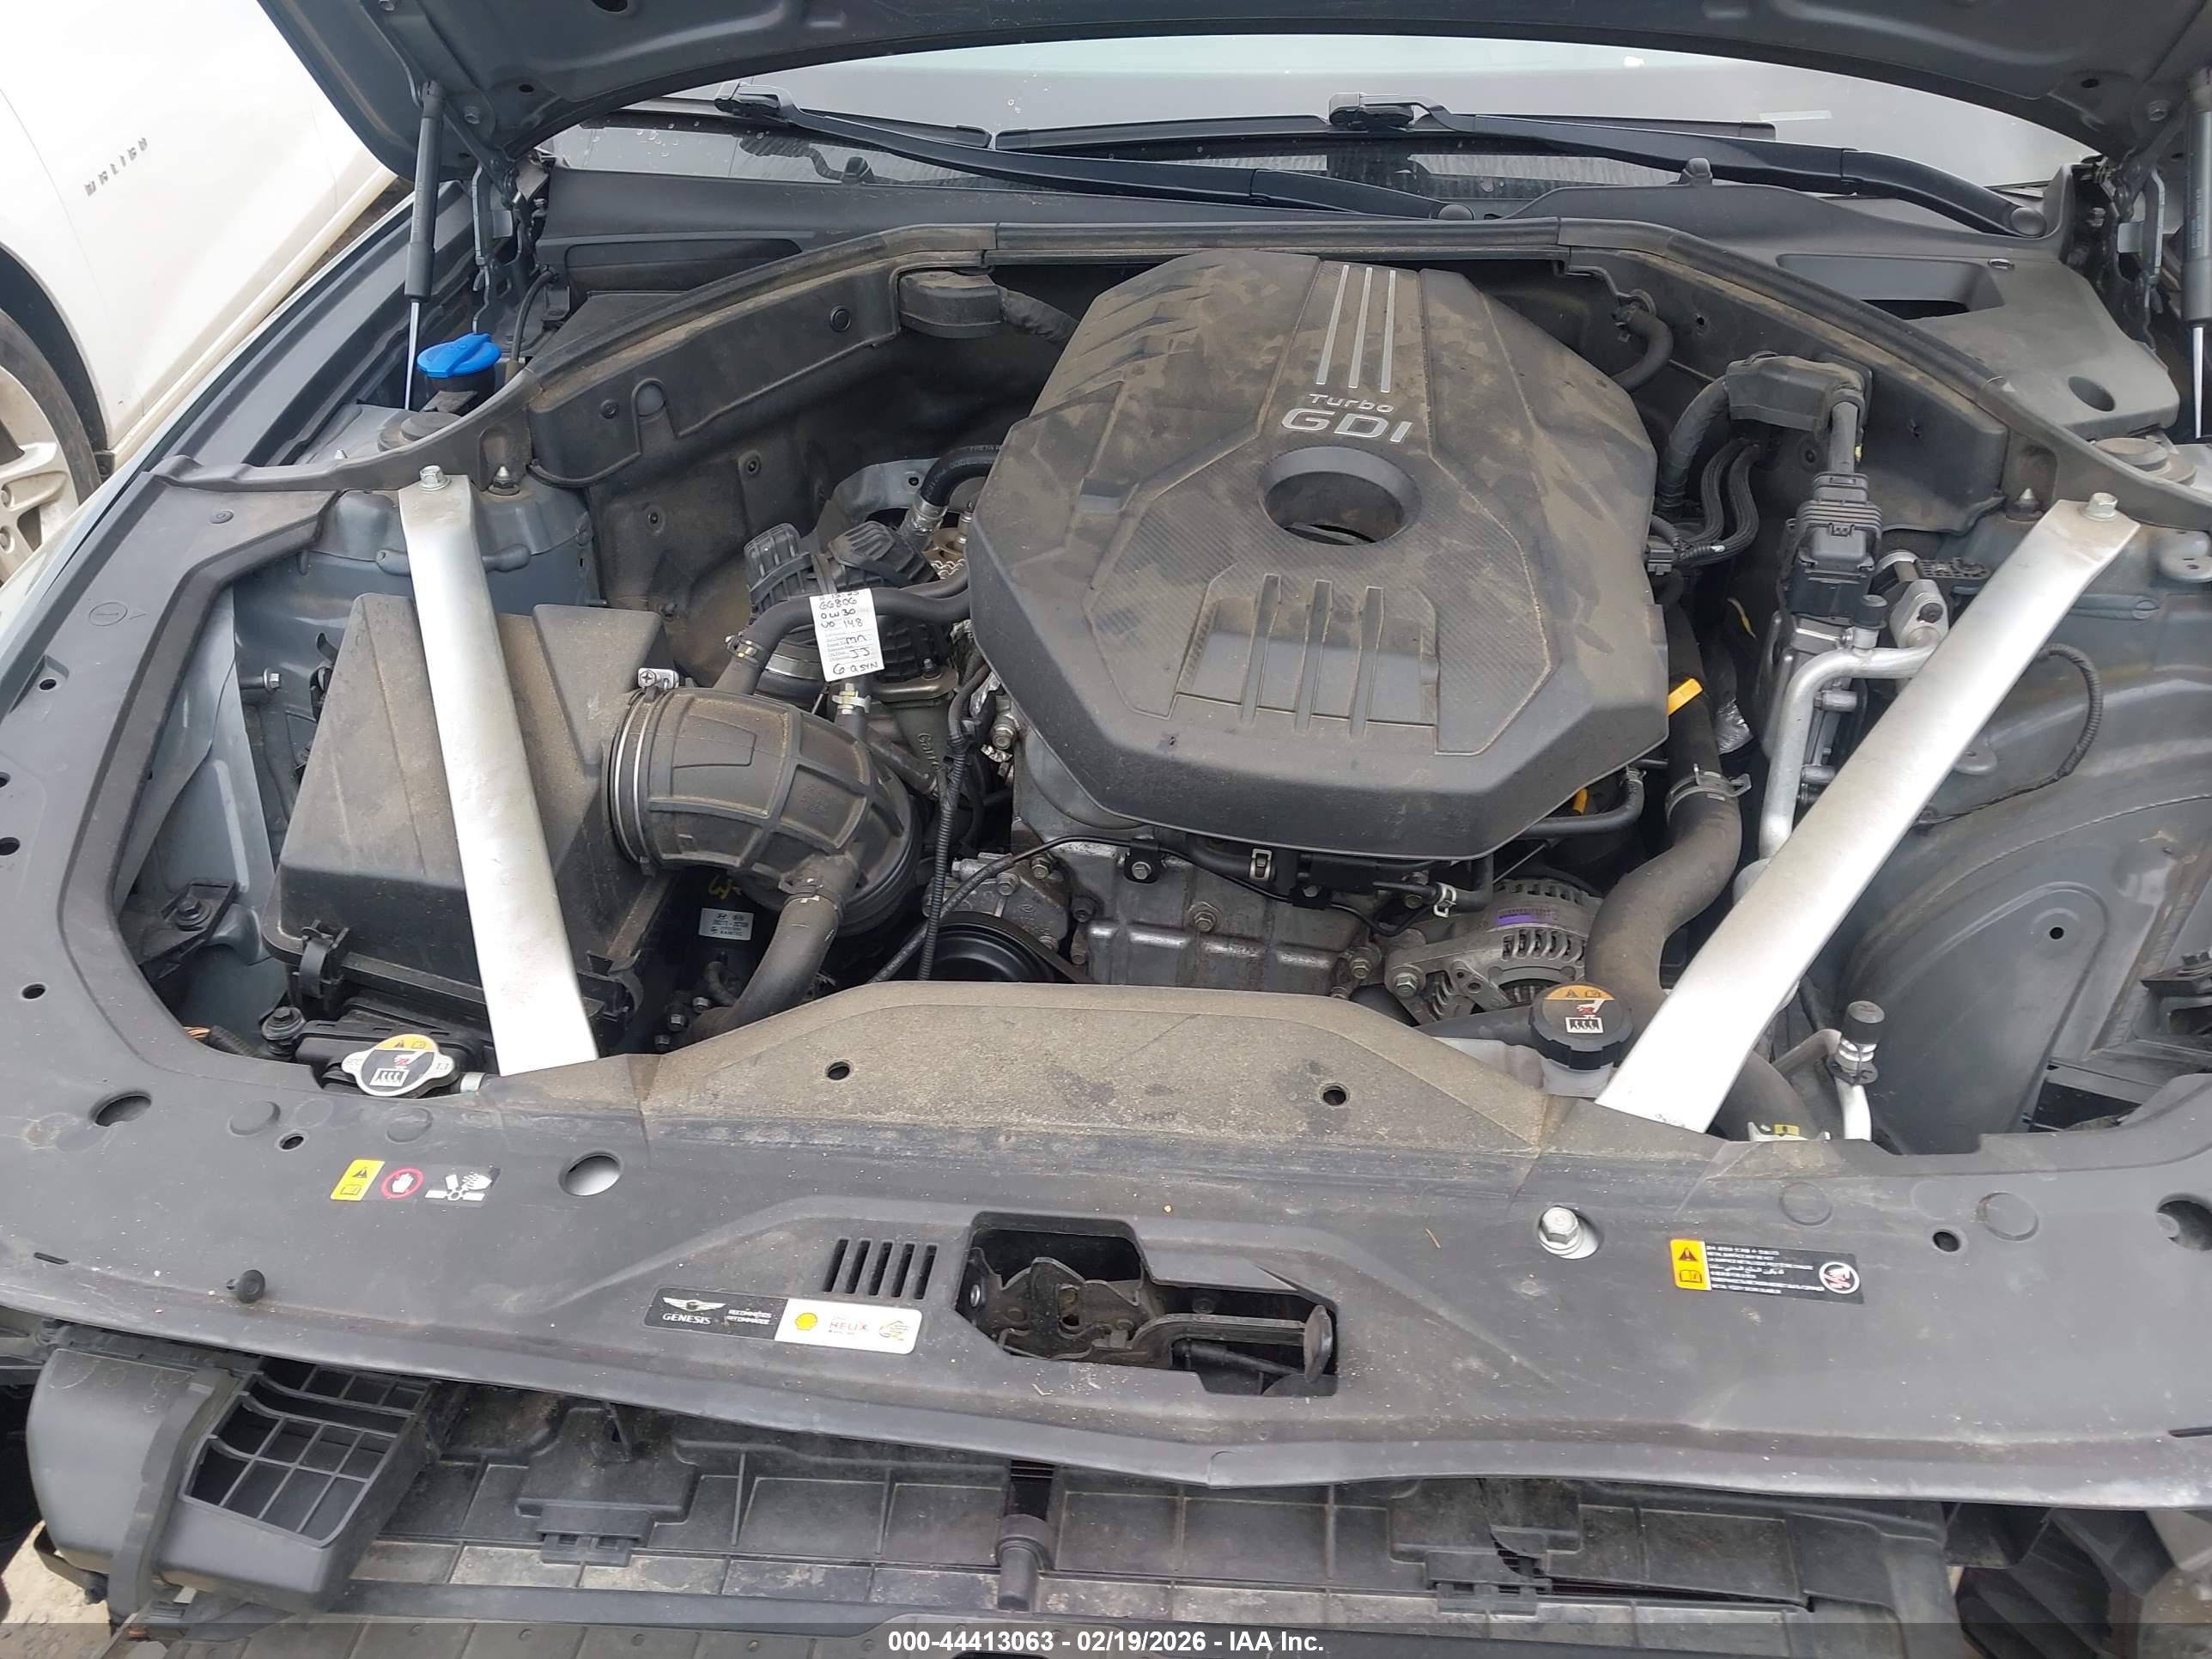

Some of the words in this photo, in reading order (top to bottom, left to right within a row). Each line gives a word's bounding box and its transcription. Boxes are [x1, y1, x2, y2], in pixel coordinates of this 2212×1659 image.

[1308, 393, 1395, 414] Turbo
[1281, 408, 1413, 443] GDI
[662, 1313, 712, 1325] GENESIS
